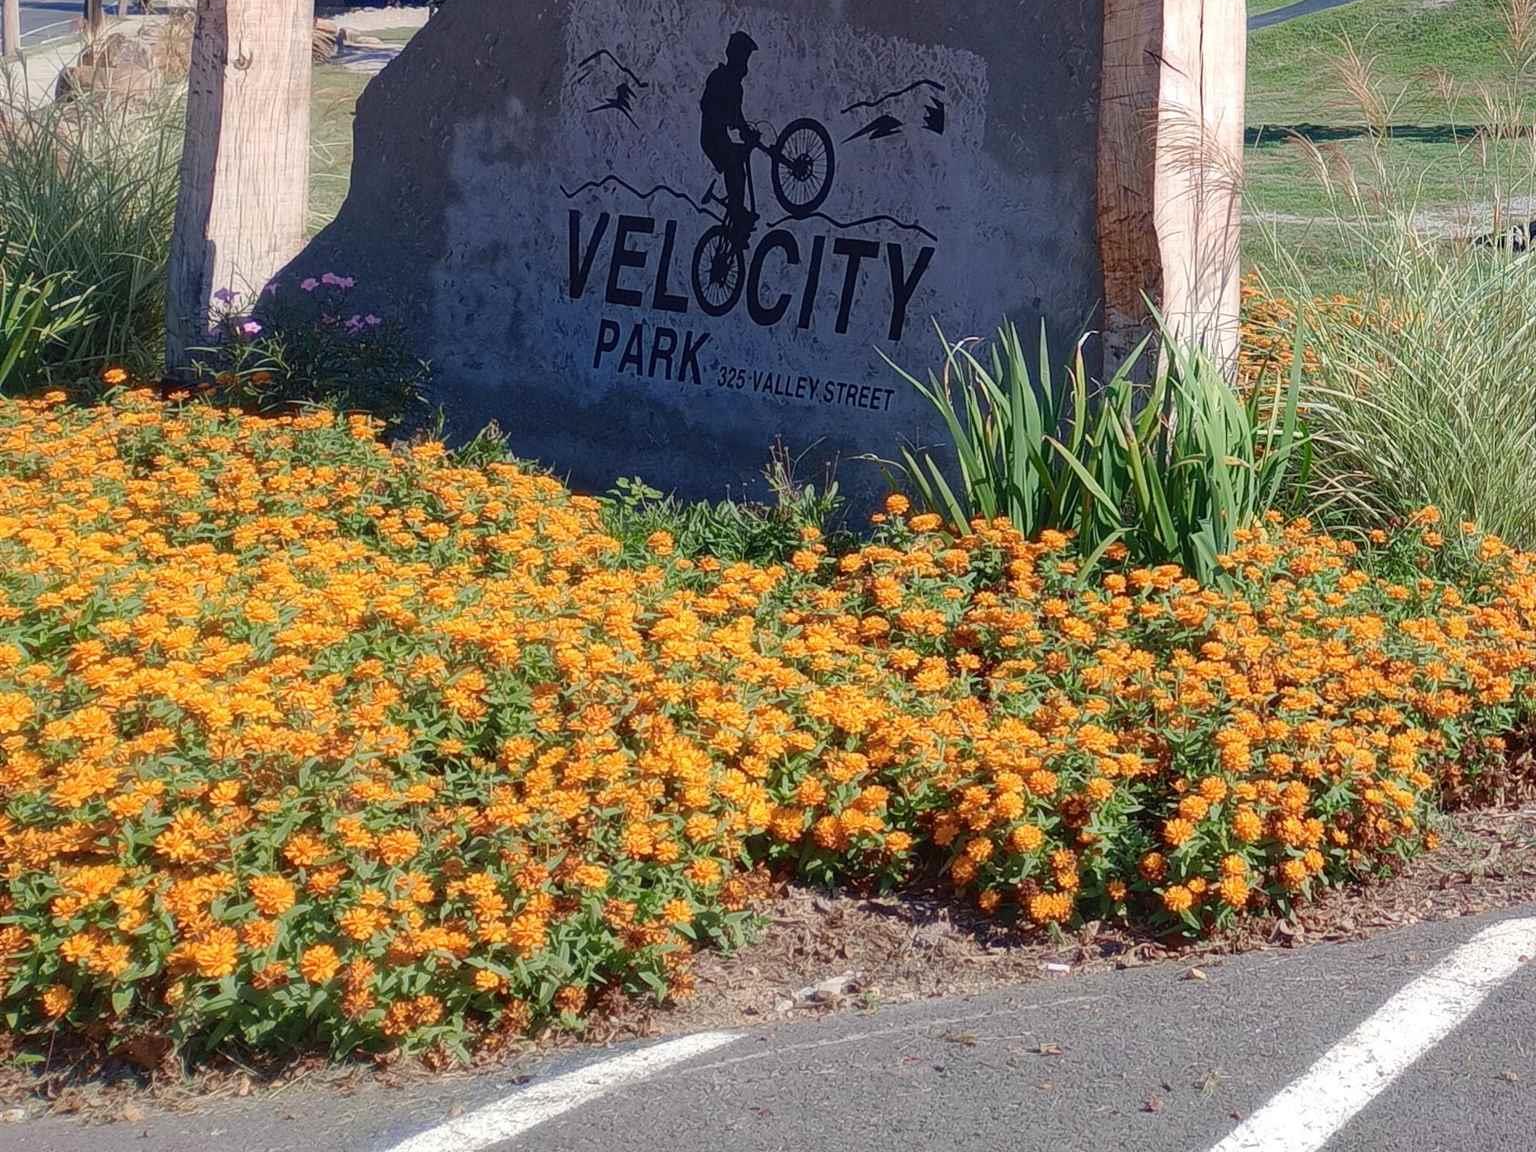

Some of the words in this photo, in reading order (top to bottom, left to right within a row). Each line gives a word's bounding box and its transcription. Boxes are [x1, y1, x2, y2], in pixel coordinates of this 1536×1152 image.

[568, 209, 935, 341] VELOCITY
[593, 319, 711, 385] PARK
[717, 366, 746, 389] 325
[752, 370, 820, 401] VALLEY
[822, 380, 896, 411] STREET
